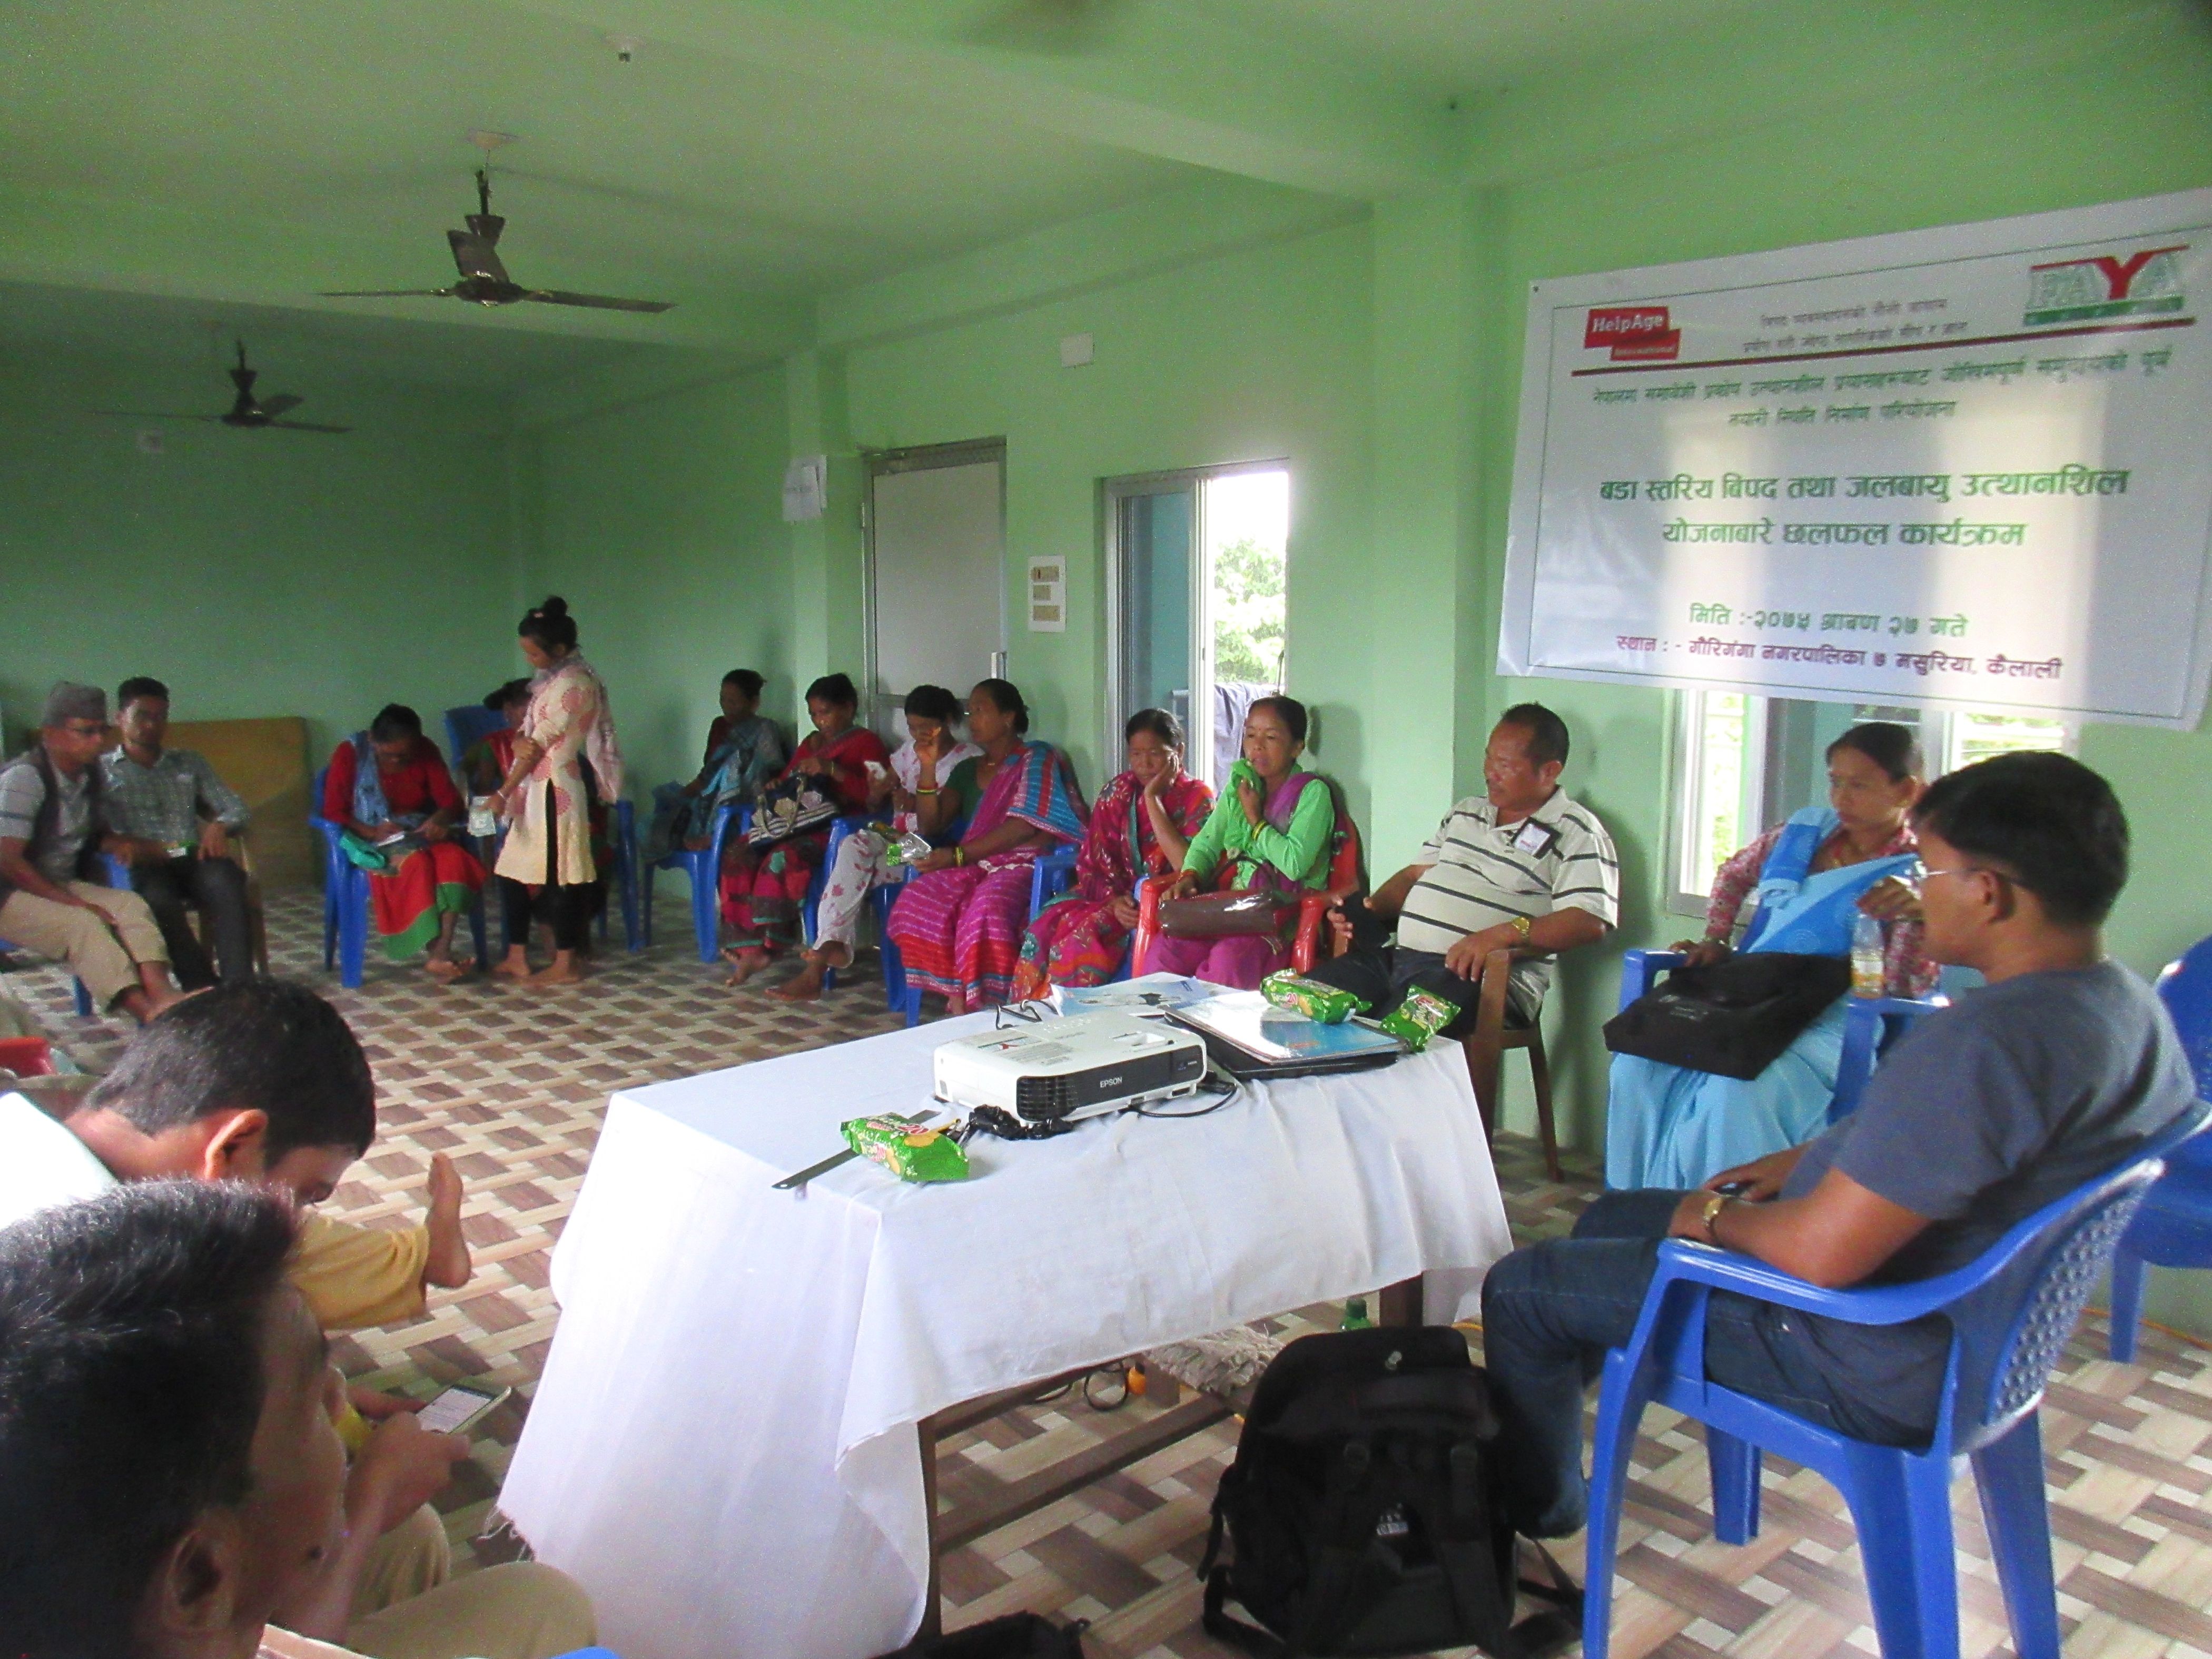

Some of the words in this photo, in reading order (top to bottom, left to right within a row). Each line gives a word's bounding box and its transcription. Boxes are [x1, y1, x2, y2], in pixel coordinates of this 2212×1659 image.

[1592, 313, 1664, 336] HelpAge
[1788, 475, 1837, 498] तथा
[1783, 522, 1891, 546] छलफल
[1899, 518, 2028, 546] कार्यक्रम
[1689, 602, 1733, 625] मिति
[1929, 613, 1969, 637] गते
[1616, 635, 1657, 652] स्थान
[1100, 1077, 1122, 1088] EPSON
